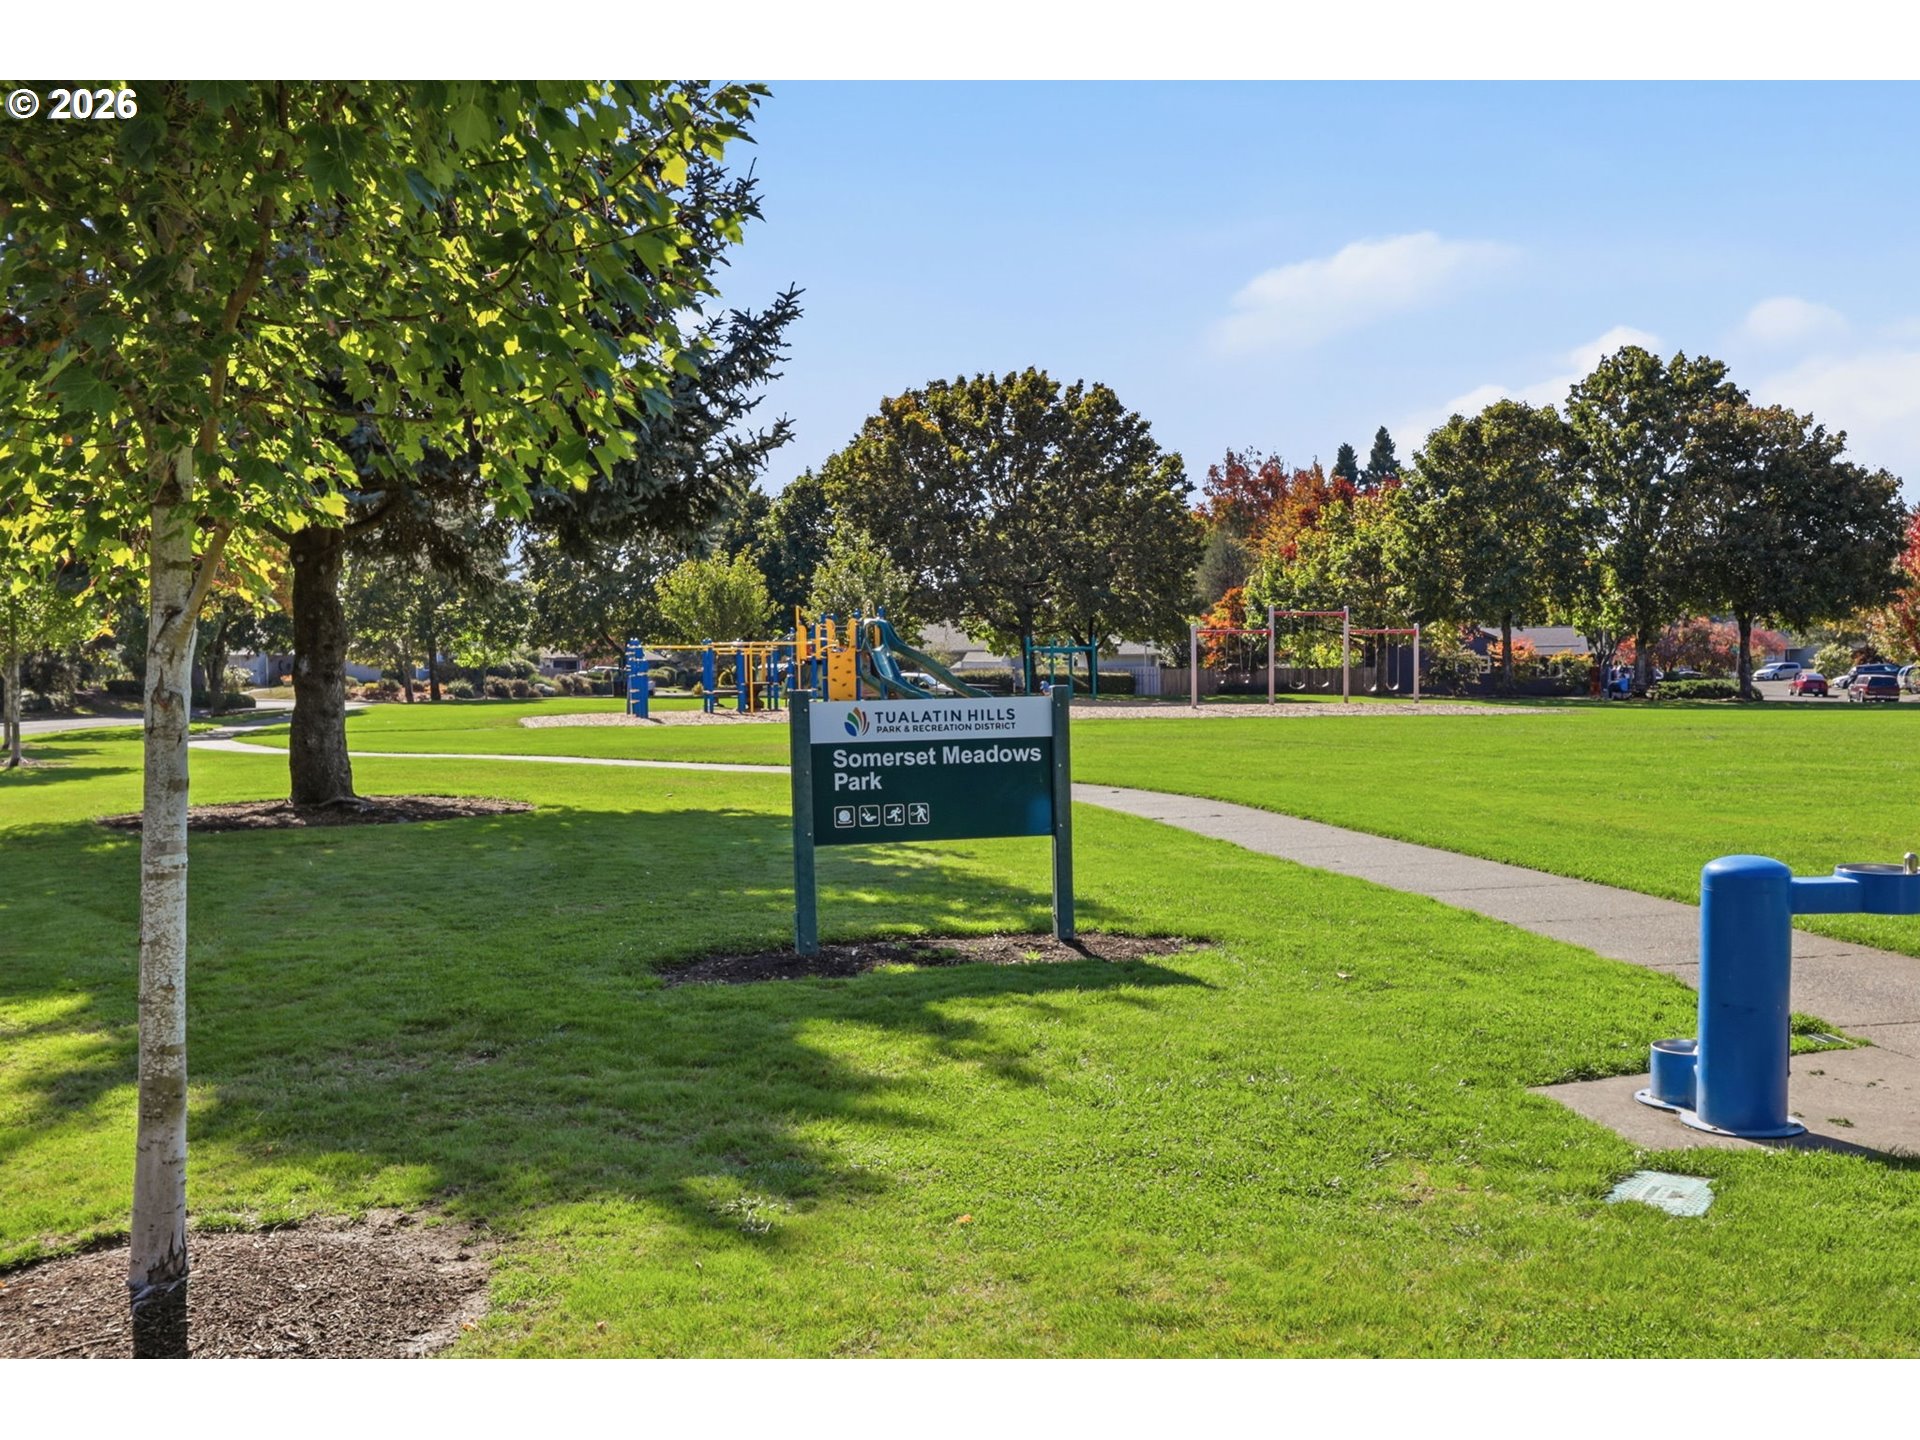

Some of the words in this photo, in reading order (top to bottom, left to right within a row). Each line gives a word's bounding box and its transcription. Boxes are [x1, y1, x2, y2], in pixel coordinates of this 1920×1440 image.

[875, 709, 962, 725] TUALATIN
[968, 708, 1016, 721] HILLS
[876, 725, 901, 733] PARK
[904, 725, 911, 733] &
[913, 723, 972, 732] RECREATION
[975, 721, 1016, 731] DISTRICT
[833, 747, 936, 768] Somerset
[943, 745, 1042, 765] Meadows
[834, 772, 882, 791] Park
